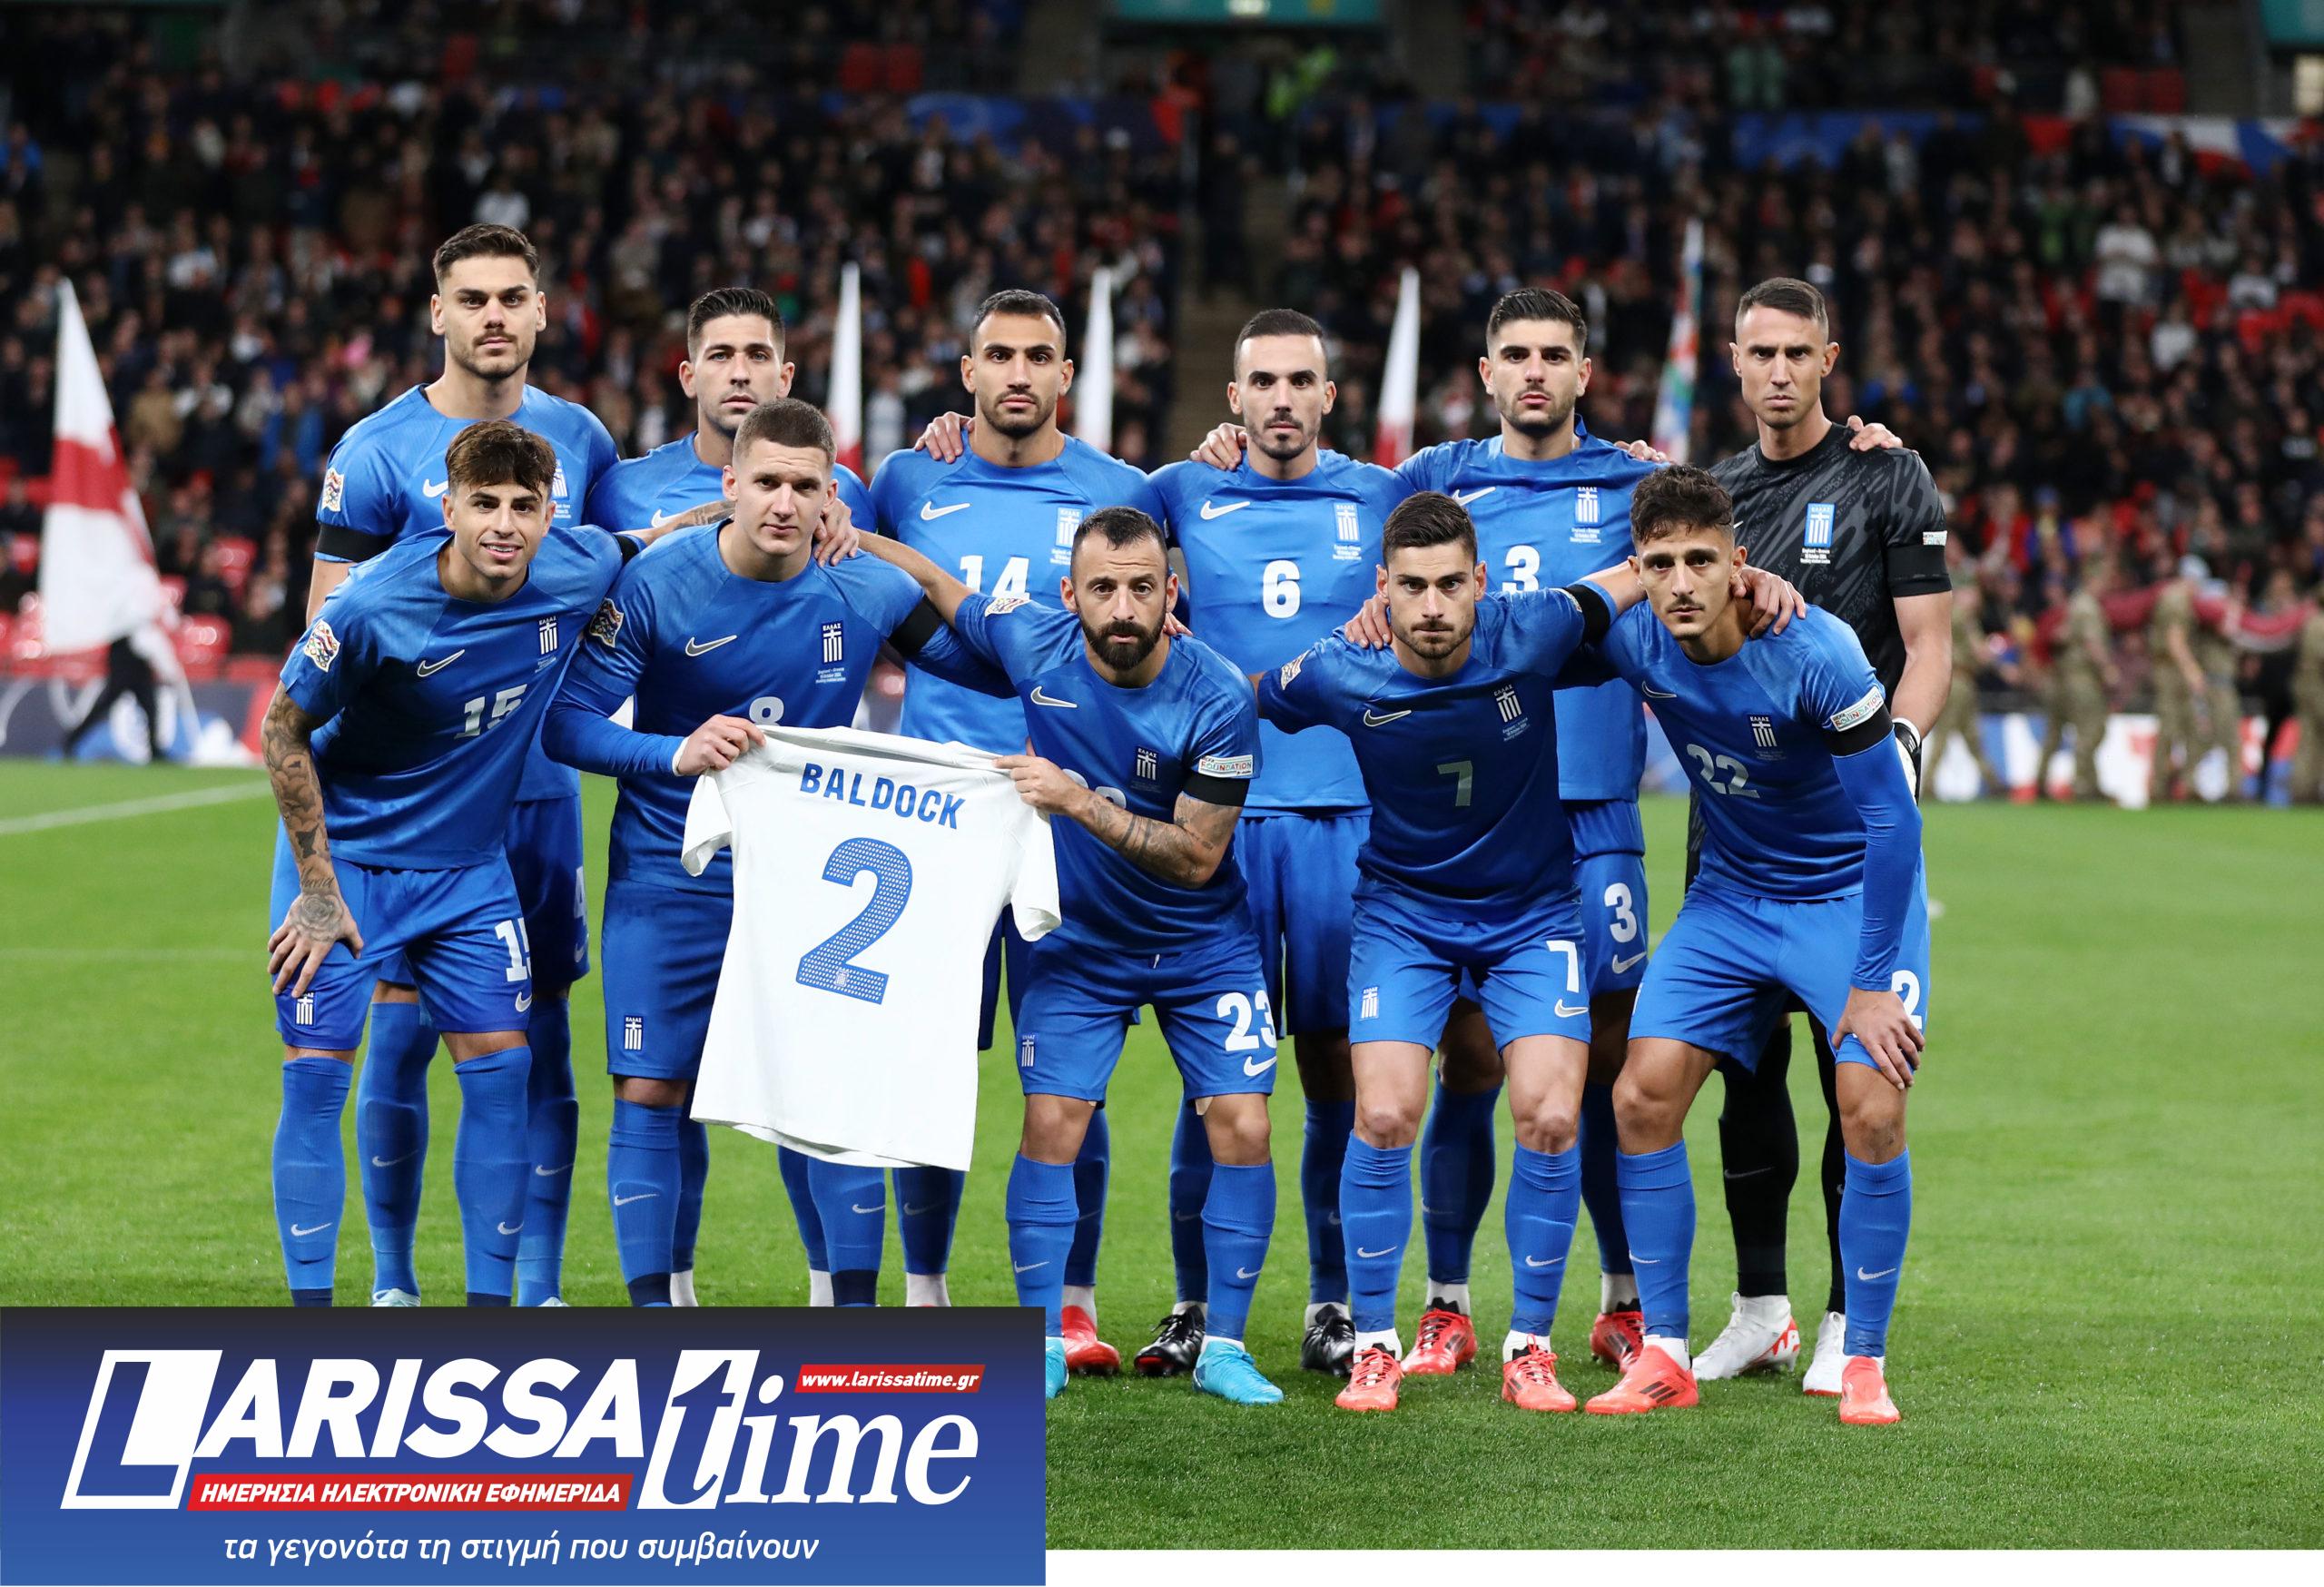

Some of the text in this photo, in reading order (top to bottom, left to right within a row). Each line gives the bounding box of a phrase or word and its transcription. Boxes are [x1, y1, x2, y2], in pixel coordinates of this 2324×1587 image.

[960, 555, 1030, 600] 14
[1263, 559, 1301, 619] 6
[1502, 545, 1541, 594] 3
[455, 684, 528, 740] 15
[800, 762, 965, 830] BALDOCK
[1437, 760, 1473, 806] 7
[1687, 744, 1761, 799] 22
[795, 837, 913, 1005] 2
[1604, 882, 1638, 943] 3
[1546, 940, 1581, 993] 7
[1216, 990, 1277, 1052] 23
